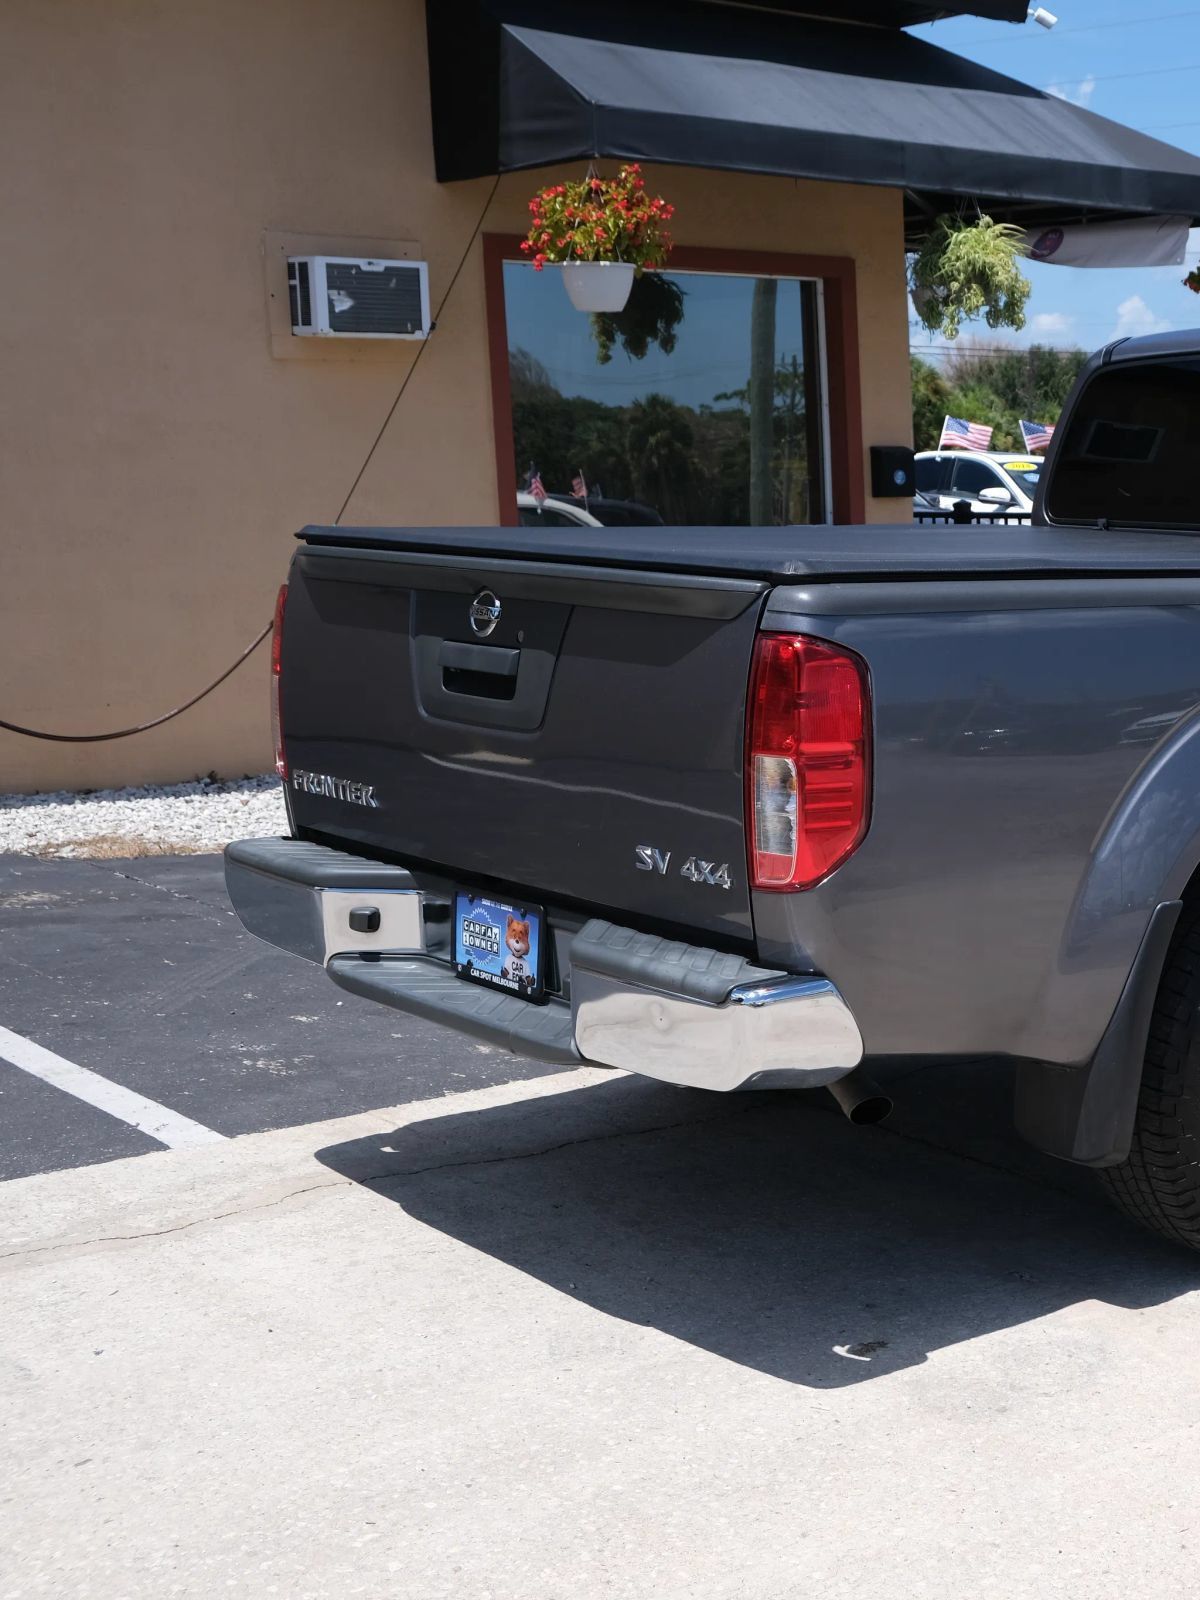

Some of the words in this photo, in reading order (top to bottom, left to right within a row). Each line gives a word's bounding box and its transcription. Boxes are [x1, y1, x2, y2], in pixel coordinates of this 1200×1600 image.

[292, 769, 381, 808] FRONTIER
[635, 844, 672, 875] SV
[463, 919, 500, 941] CARFAX
[469, 935, 499, 953] OWNER
[512, 961, 524, 974] CAR
[470, 968, 480, 977] CAR
[479, 971, 492, 982] SPOT
[492, 975, 519, 990] MELBOURNE
